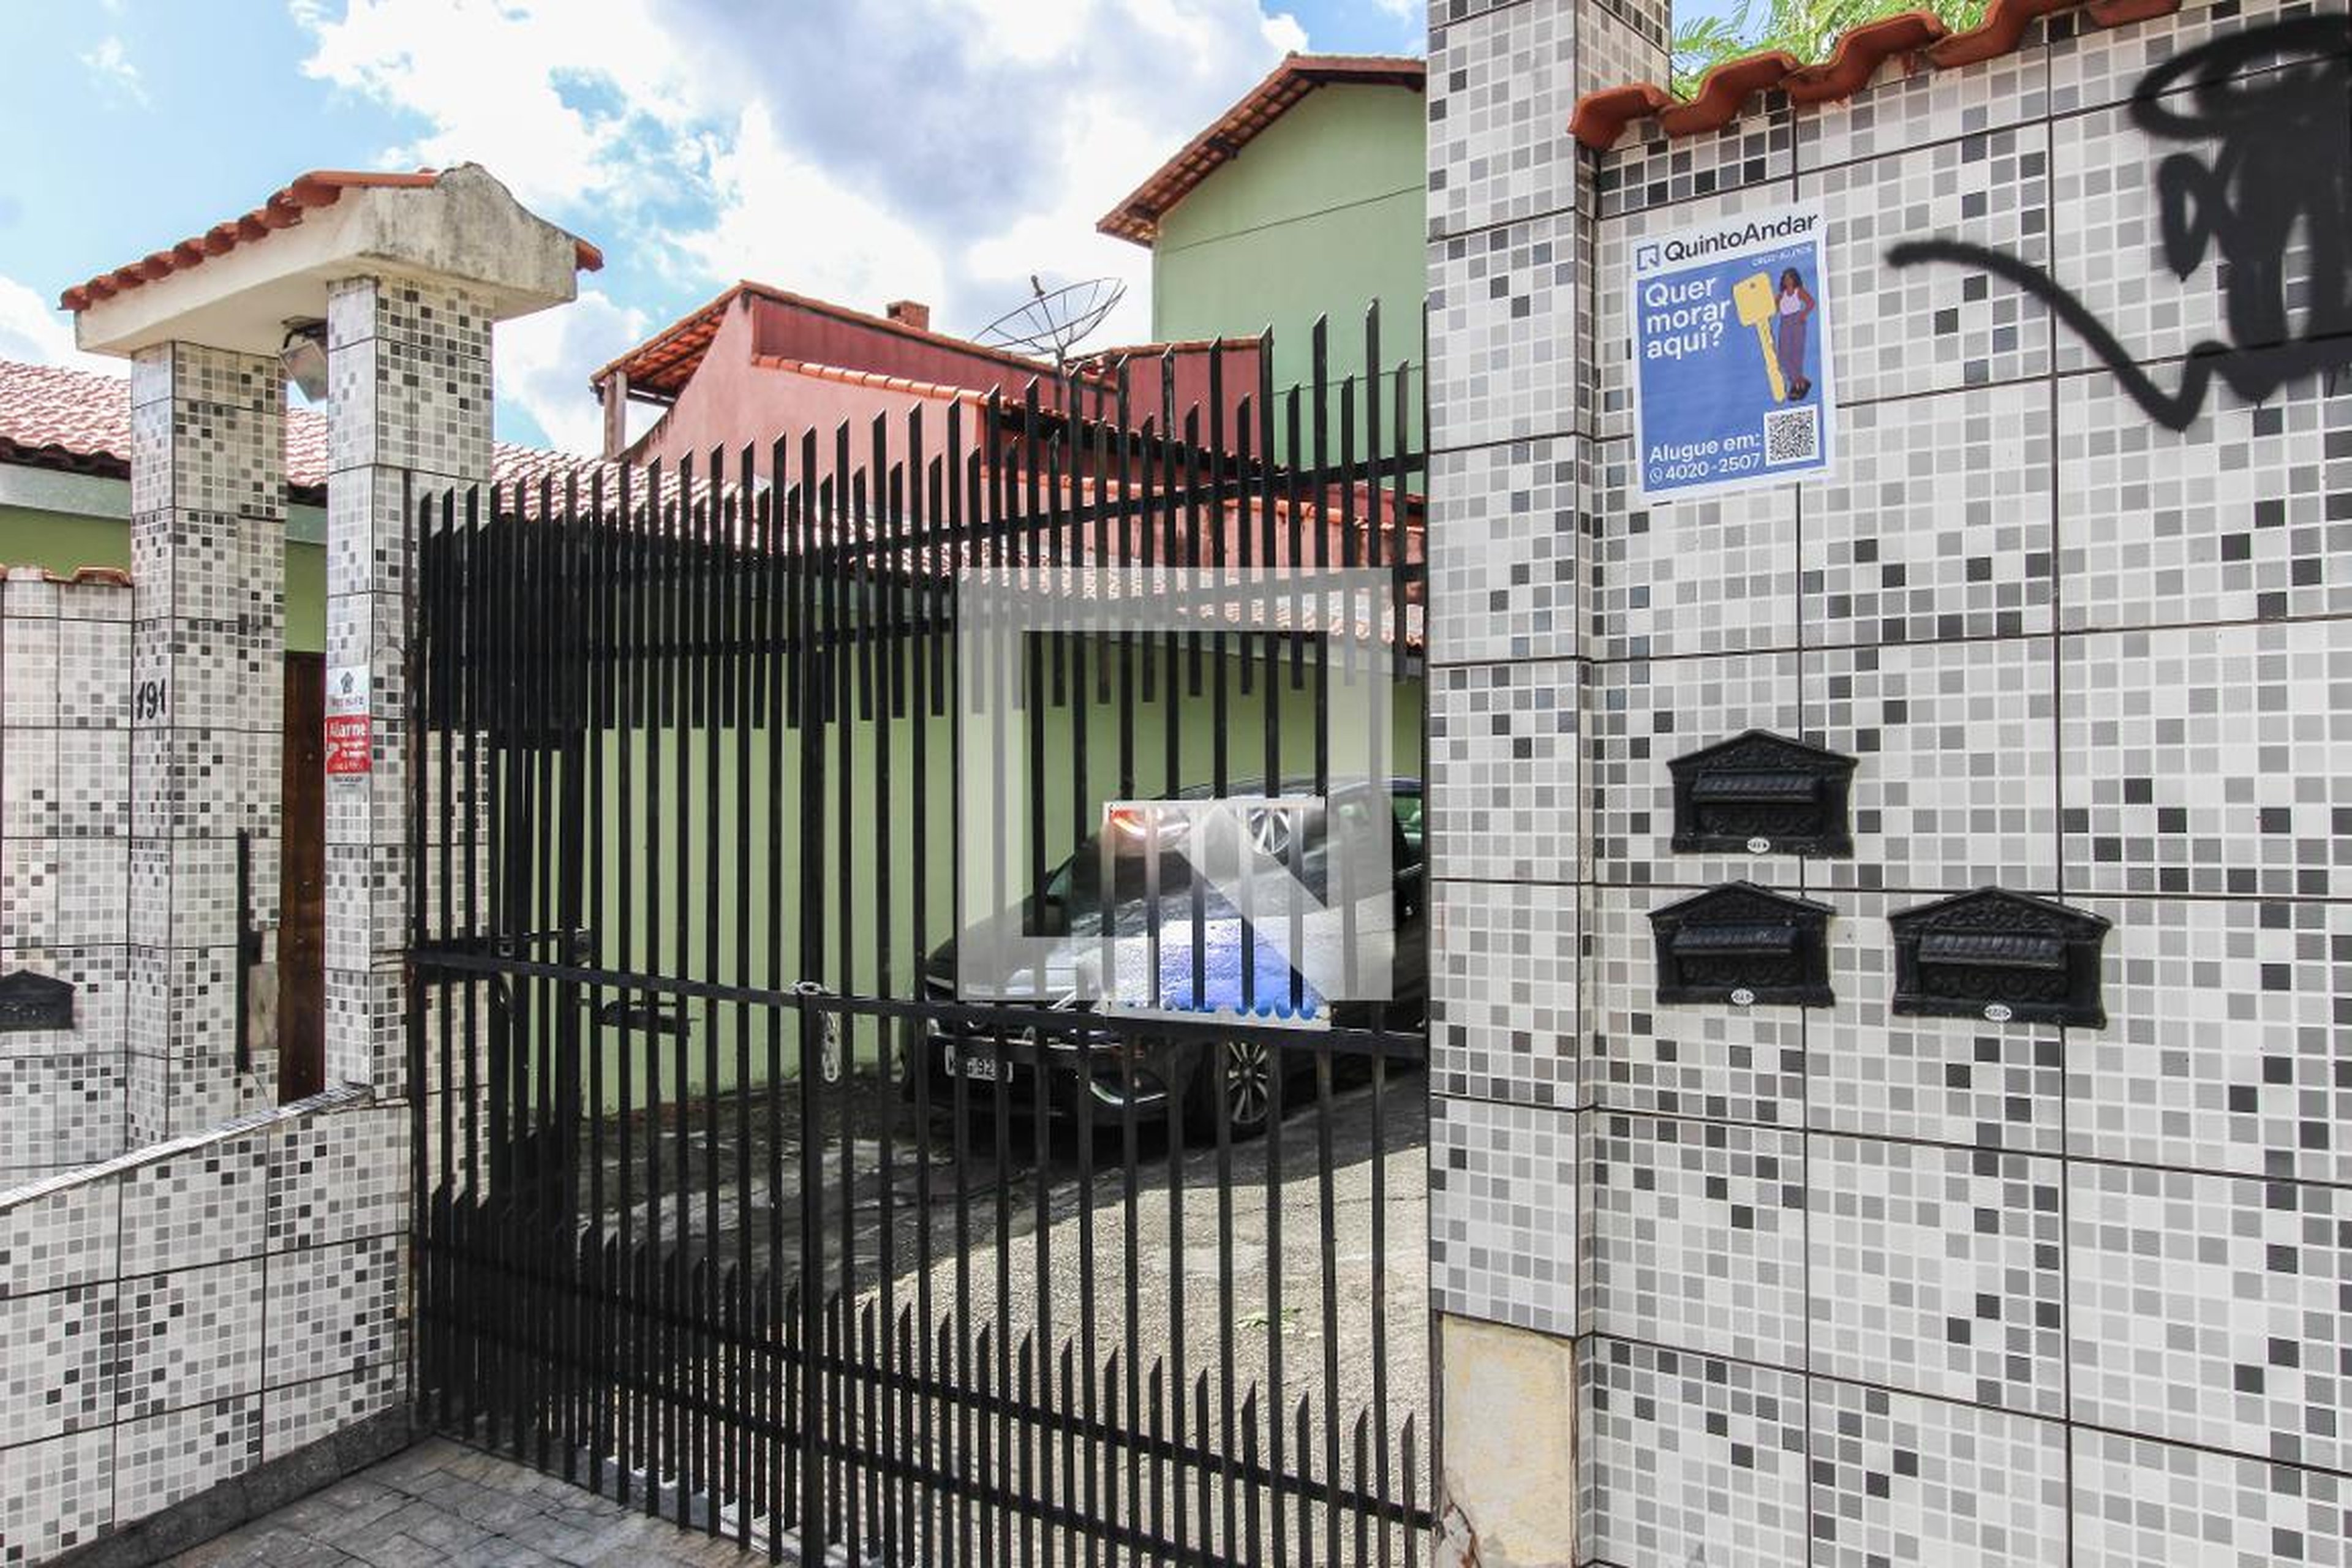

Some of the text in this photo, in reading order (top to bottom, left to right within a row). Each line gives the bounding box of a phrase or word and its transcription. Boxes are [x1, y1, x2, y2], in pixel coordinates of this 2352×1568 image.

[1665, 214, 1817, 261] QuintoAndar
[1645, 277, 1717, 306] Quer
[1646, 300, 1731, 334] morar
[1647, 322, 1724, 360] aqui?
[1649, 433, 1761, 464] Alugue em:
[137, 677, 166, 720] 191
